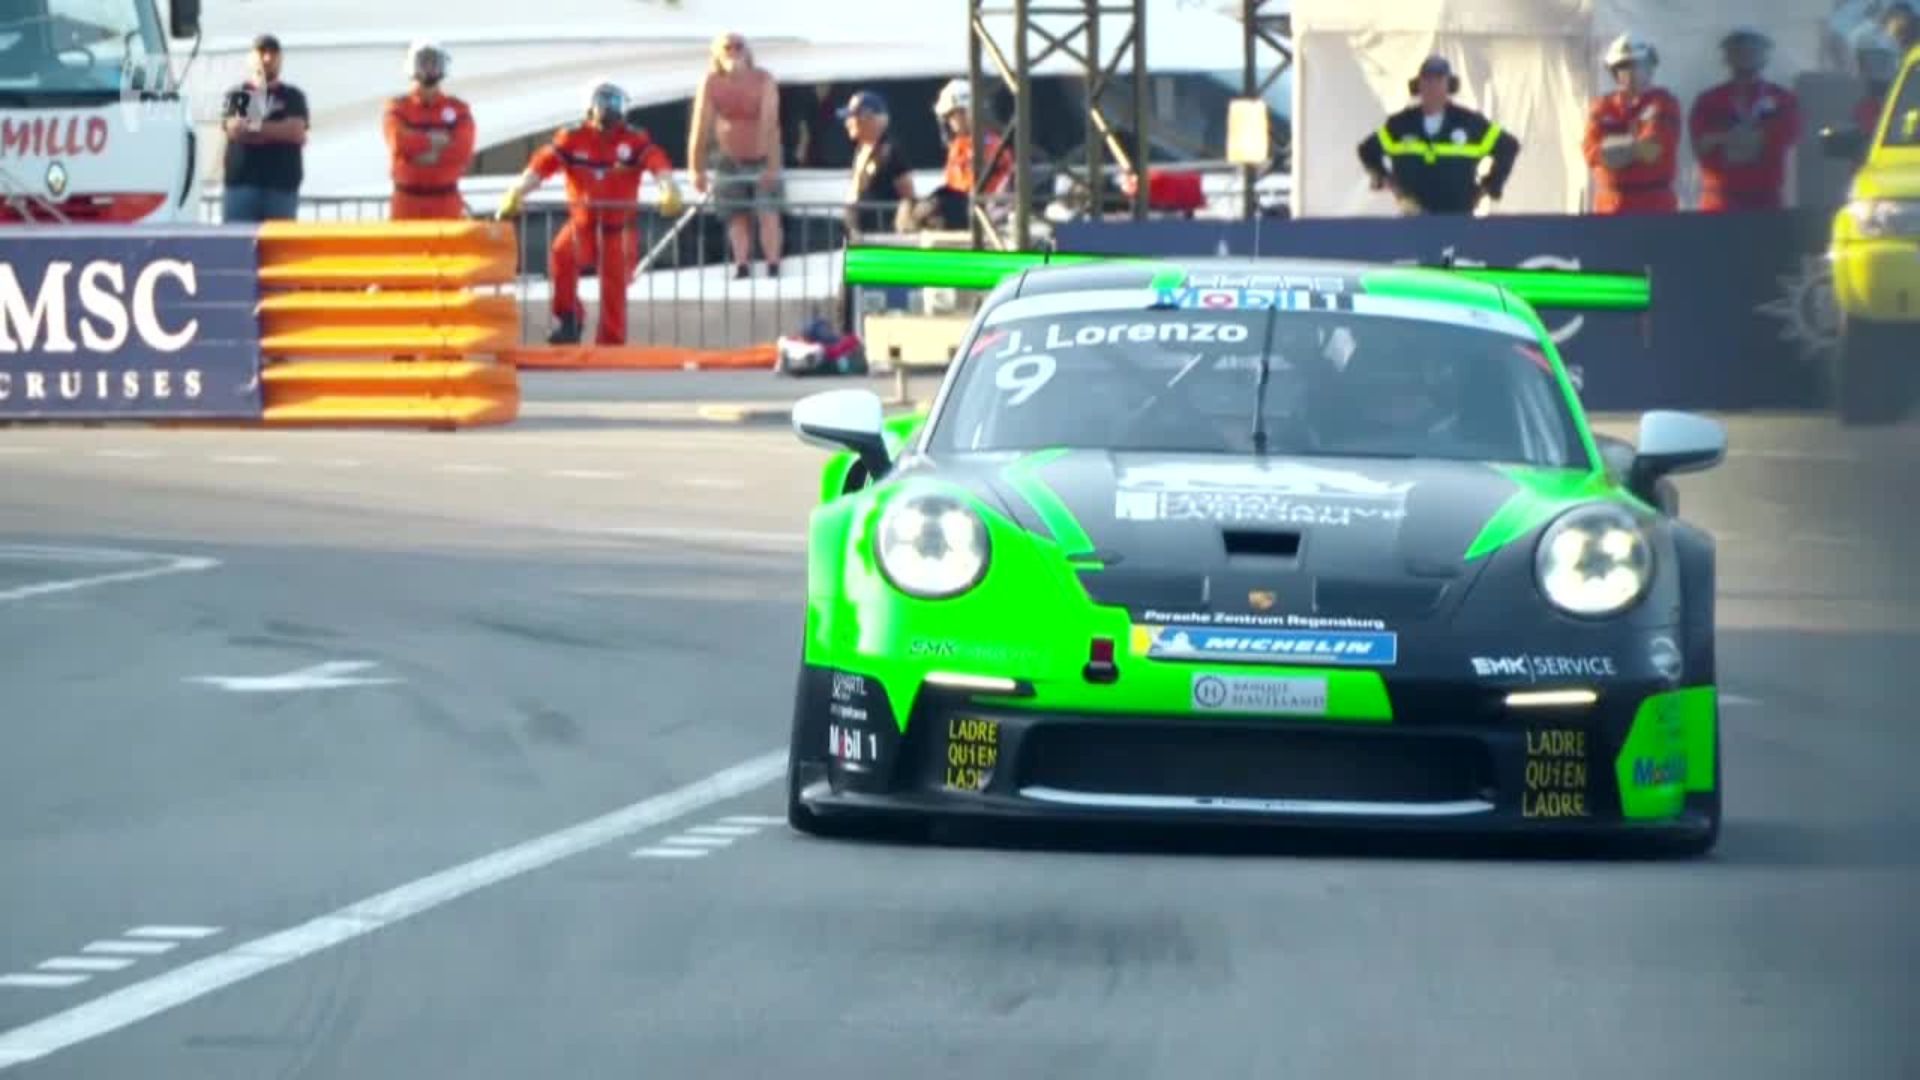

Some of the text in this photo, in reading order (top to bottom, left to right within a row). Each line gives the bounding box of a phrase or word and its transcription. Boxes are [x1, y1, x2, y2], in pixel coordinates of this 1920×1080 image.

[0, 258, 198, 352] MSC
[1046, 321, 1248, 349] Lorenzo
[995, 354, 1057, 405] 9
[1213, 612, 1284, 627] Zentrum
[1287, 614, 1385, 630] Regensburg
[1205, 635, 1373, 655] MICHELIN
[1533, 655, 1618, 676] SERVICE
[949, 719, 998, 744] LADRE
[1526, 731, 1585, 757] LADRE
[868, 733, 877, 761] 1
